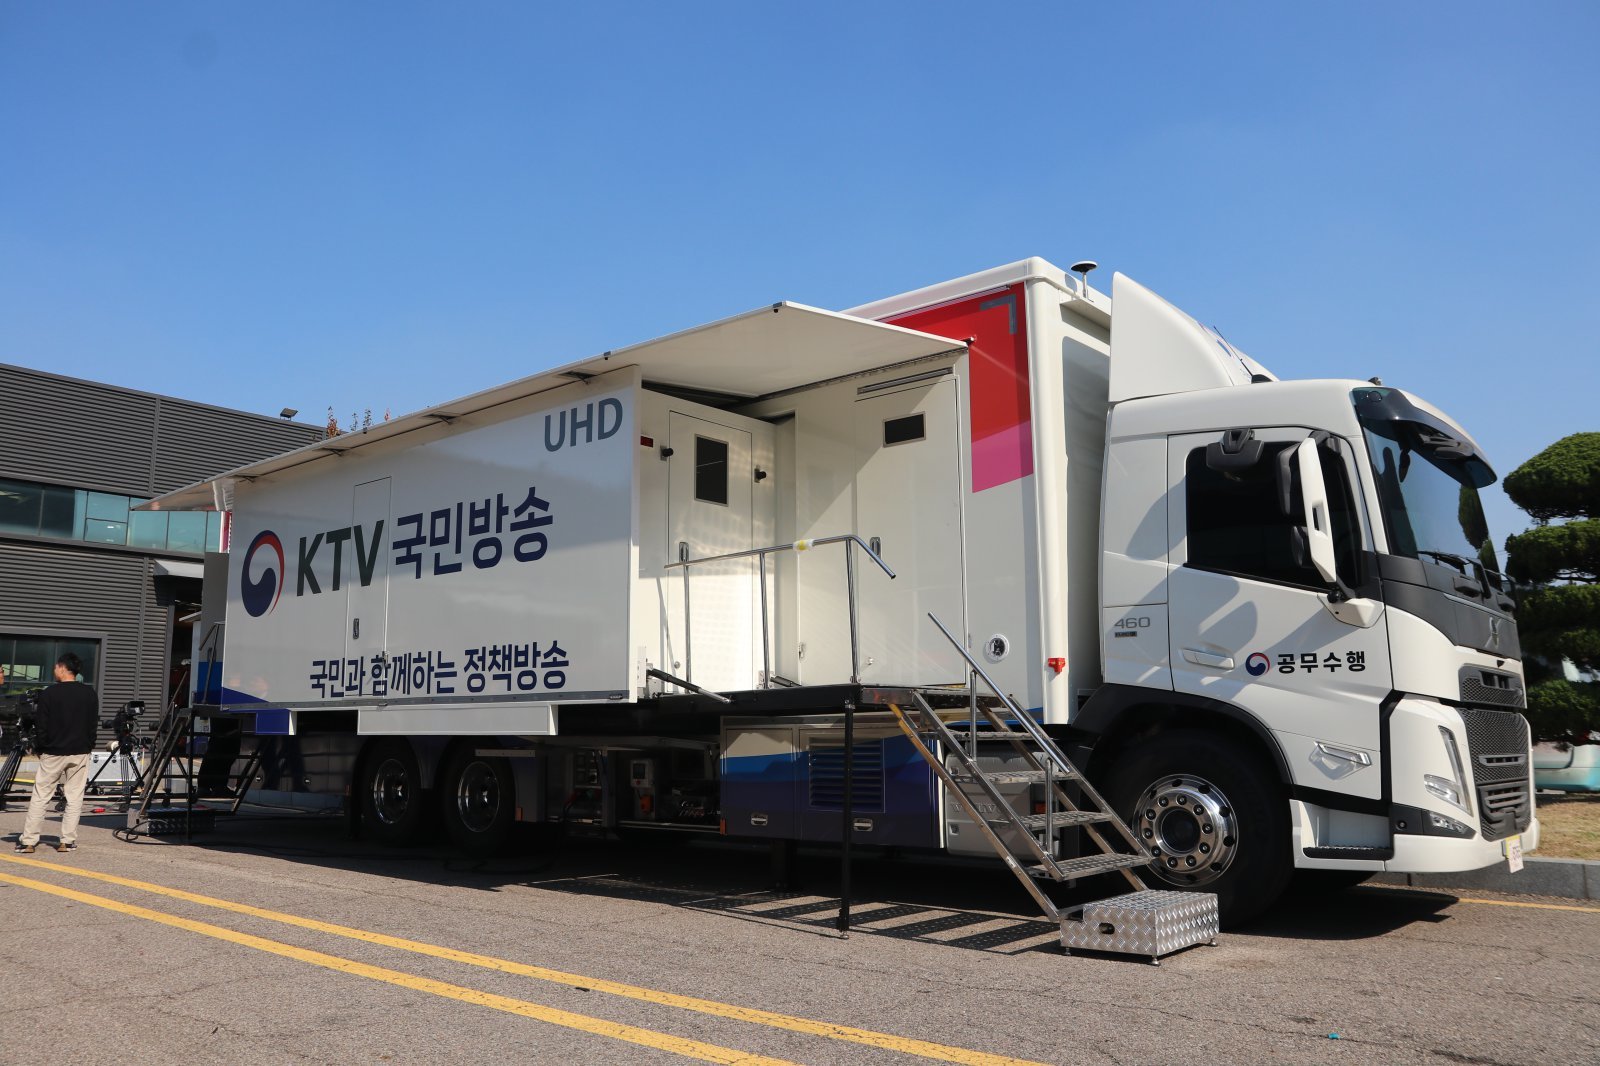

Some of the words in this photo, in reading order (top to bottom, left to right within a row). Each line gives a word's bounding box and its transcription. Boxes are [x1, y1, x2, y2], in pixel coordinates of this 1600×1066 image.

[544, 397, 623, 452] UHD
[296, 519, 384, 597] KTV
[392, 486, 553, 579] 국민방송
[1114, 616, 1151, 629] 460
[309, 656, 366, 698] 국민과
[370, 650, 457, 697] 함께하는
[463, 640, 569, 693] 정책방송
[1277, 650, 1366, 674] 공무수행
